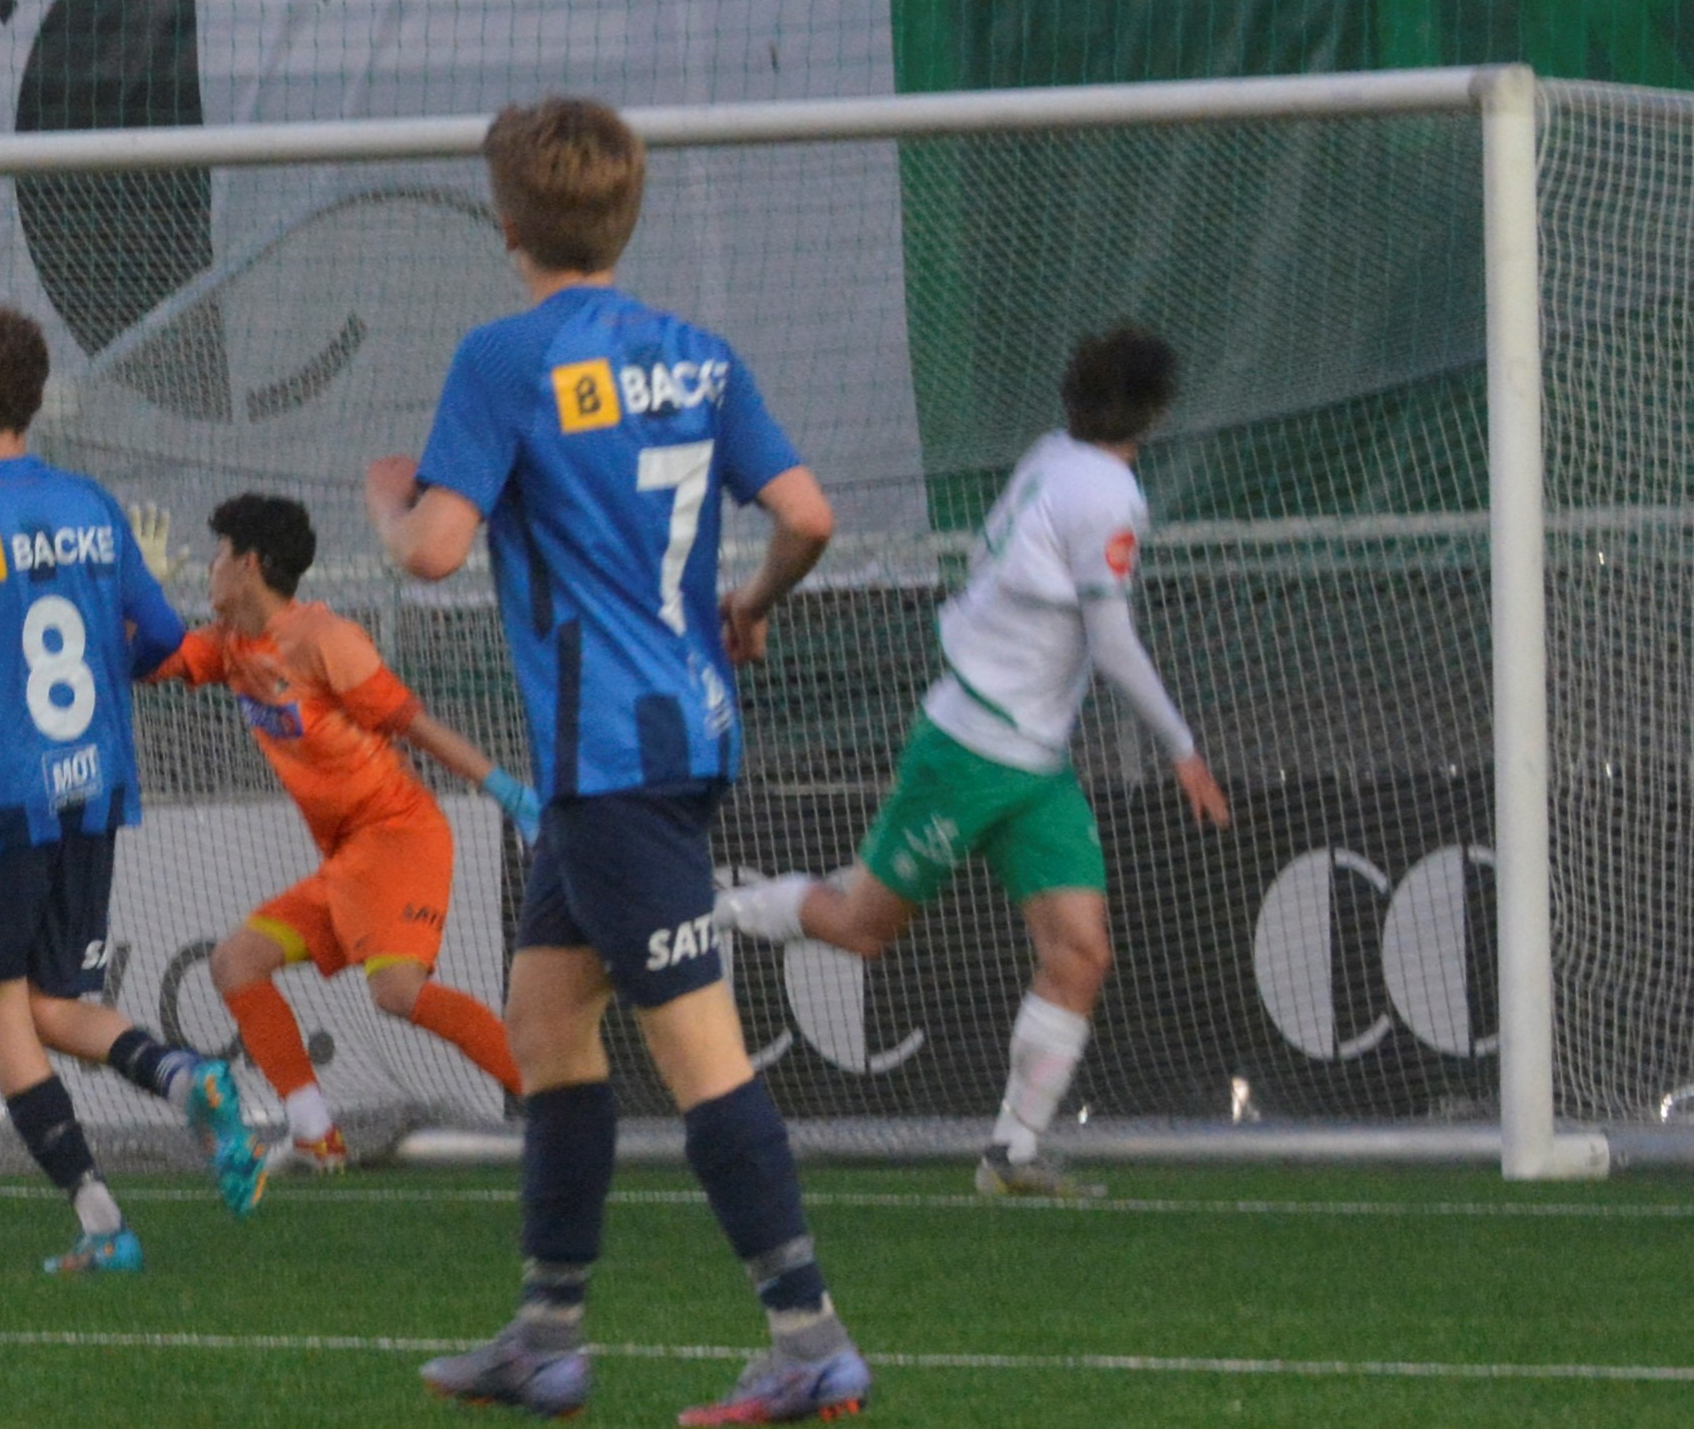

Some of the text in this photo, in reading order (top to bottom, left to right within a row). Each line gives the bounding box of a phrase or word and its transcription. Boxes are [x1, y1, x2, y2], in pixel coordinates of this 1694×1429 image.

[11, 525, 115, 571] BACKE
[636, 438, 715, 637] 7
[22, 594, 96, 742] 8
[52, 745, 98, 795] MOT
[645, 914, 721, 971] SAT
